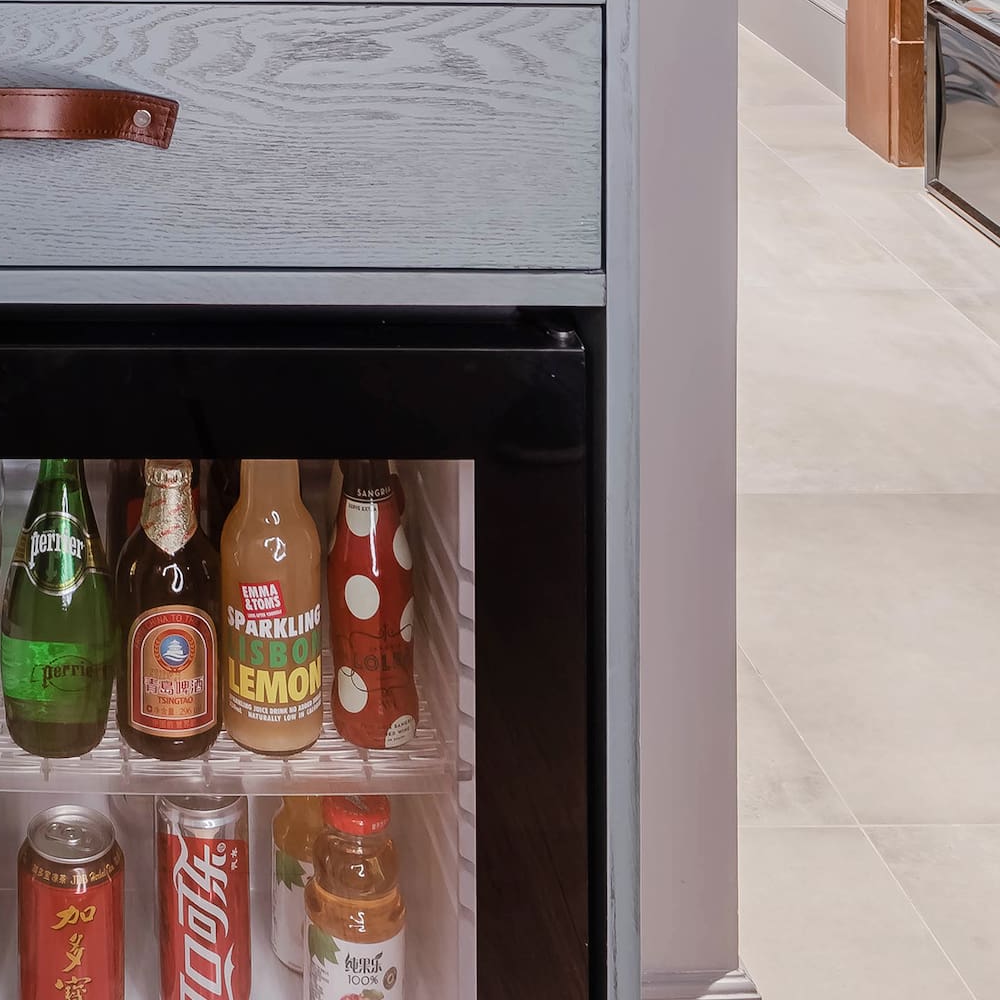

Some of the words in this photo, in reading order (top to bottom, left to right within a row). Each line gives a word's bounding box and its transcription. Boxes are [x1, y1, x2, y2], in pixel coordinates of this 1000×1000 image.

[241, 583, 278, 598] EMMA
[226, 603, 322, 639] SPARKLING
[228, 656, 322, 704] LEMON
[157, 695, 194, 705] TSINGTAO
[247, 710, 282, 722] NATURALLY
[283, 712, 297, 722] LOW
[298, 711, 305, 719] IN
[269, 706, 289, 715] DRINK
[289, 705, 297, 713] NO
[345, 952, 384, 974] 纯果乐
[347, 974, 379, 986] 100%
